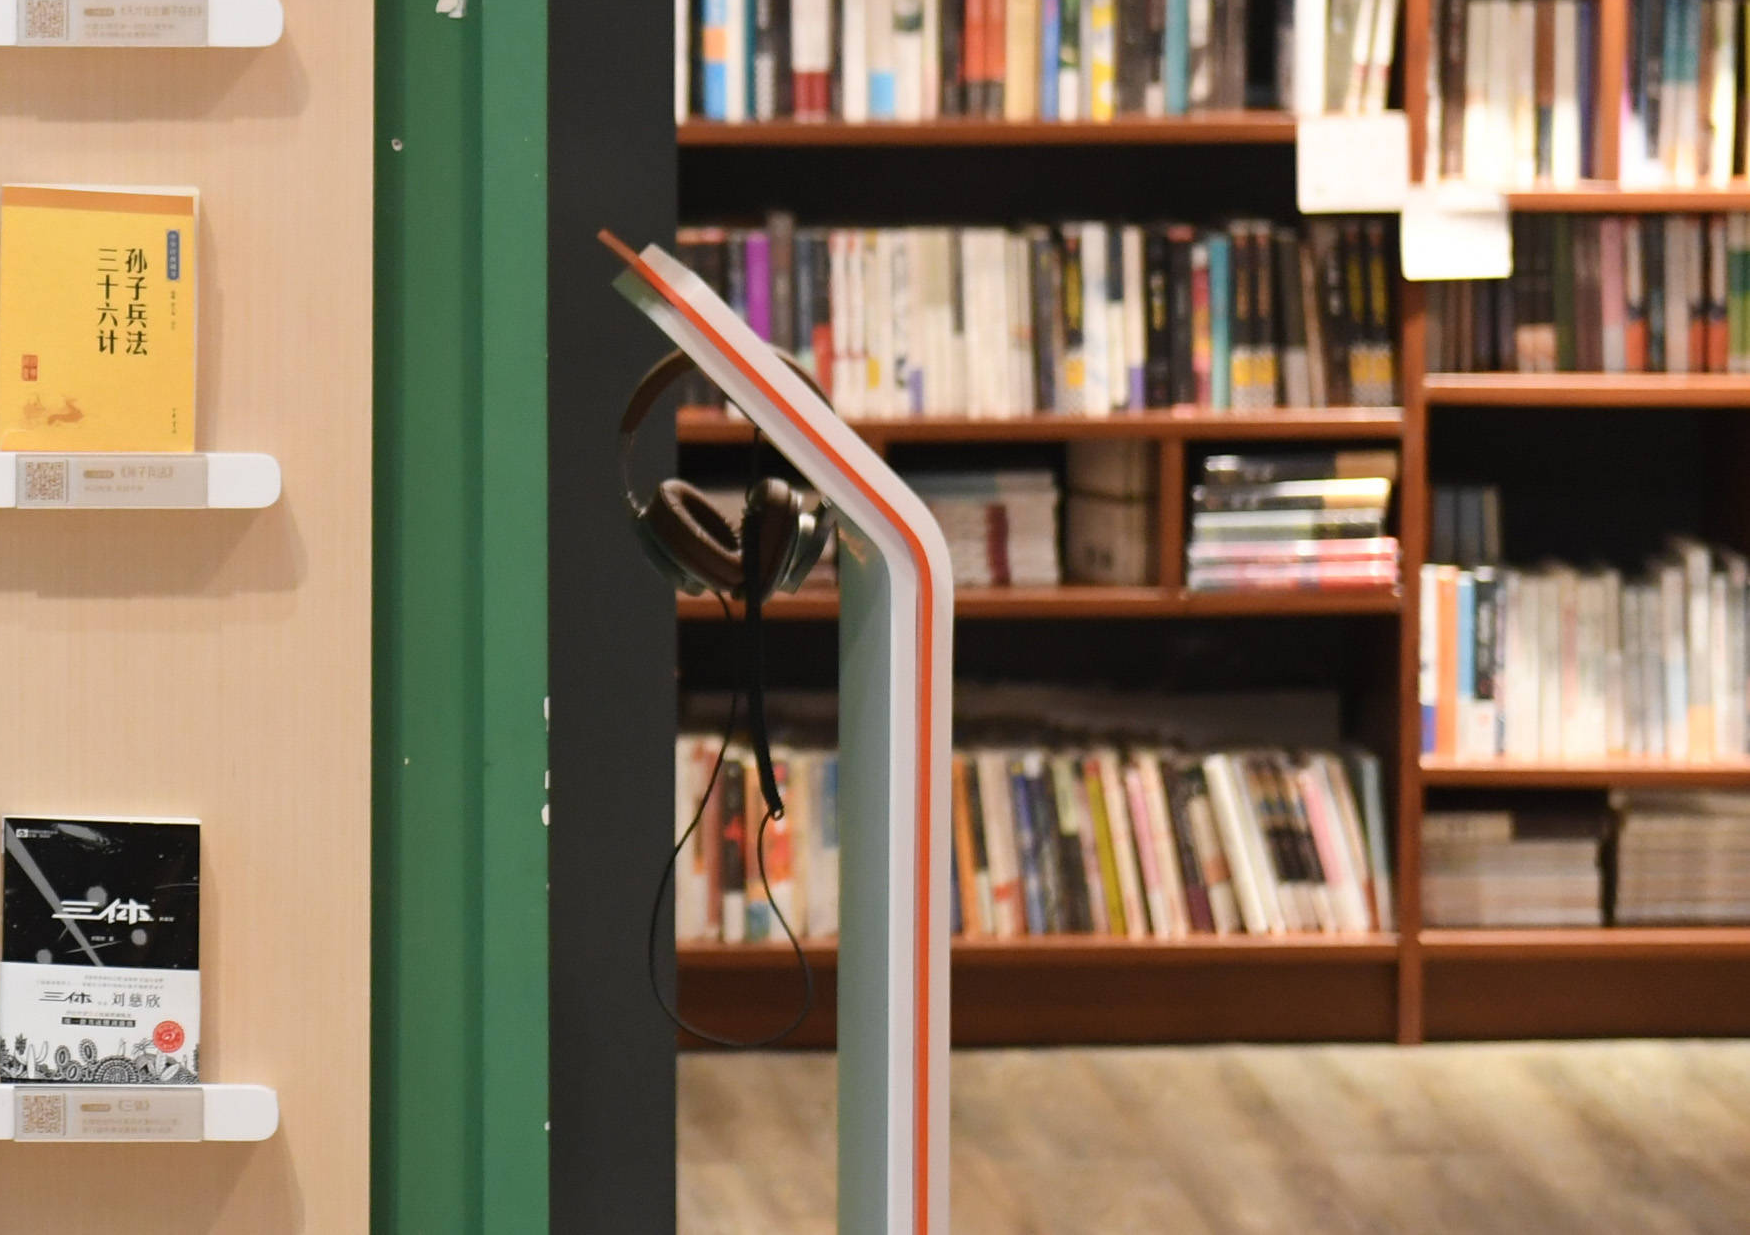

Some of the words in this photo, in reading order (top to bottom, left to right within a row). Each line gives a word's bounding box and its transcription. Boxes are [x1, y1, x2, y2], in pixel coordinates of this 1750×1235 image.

[97, 248, 119, 355] 三十六计
[125, 248, 148, 356] 孙子兵法
[51, 898, 155, 926] 三体
[38, 991, 93, 1005] 三体
[113, 992, 162, 1009] 刘慈欣
